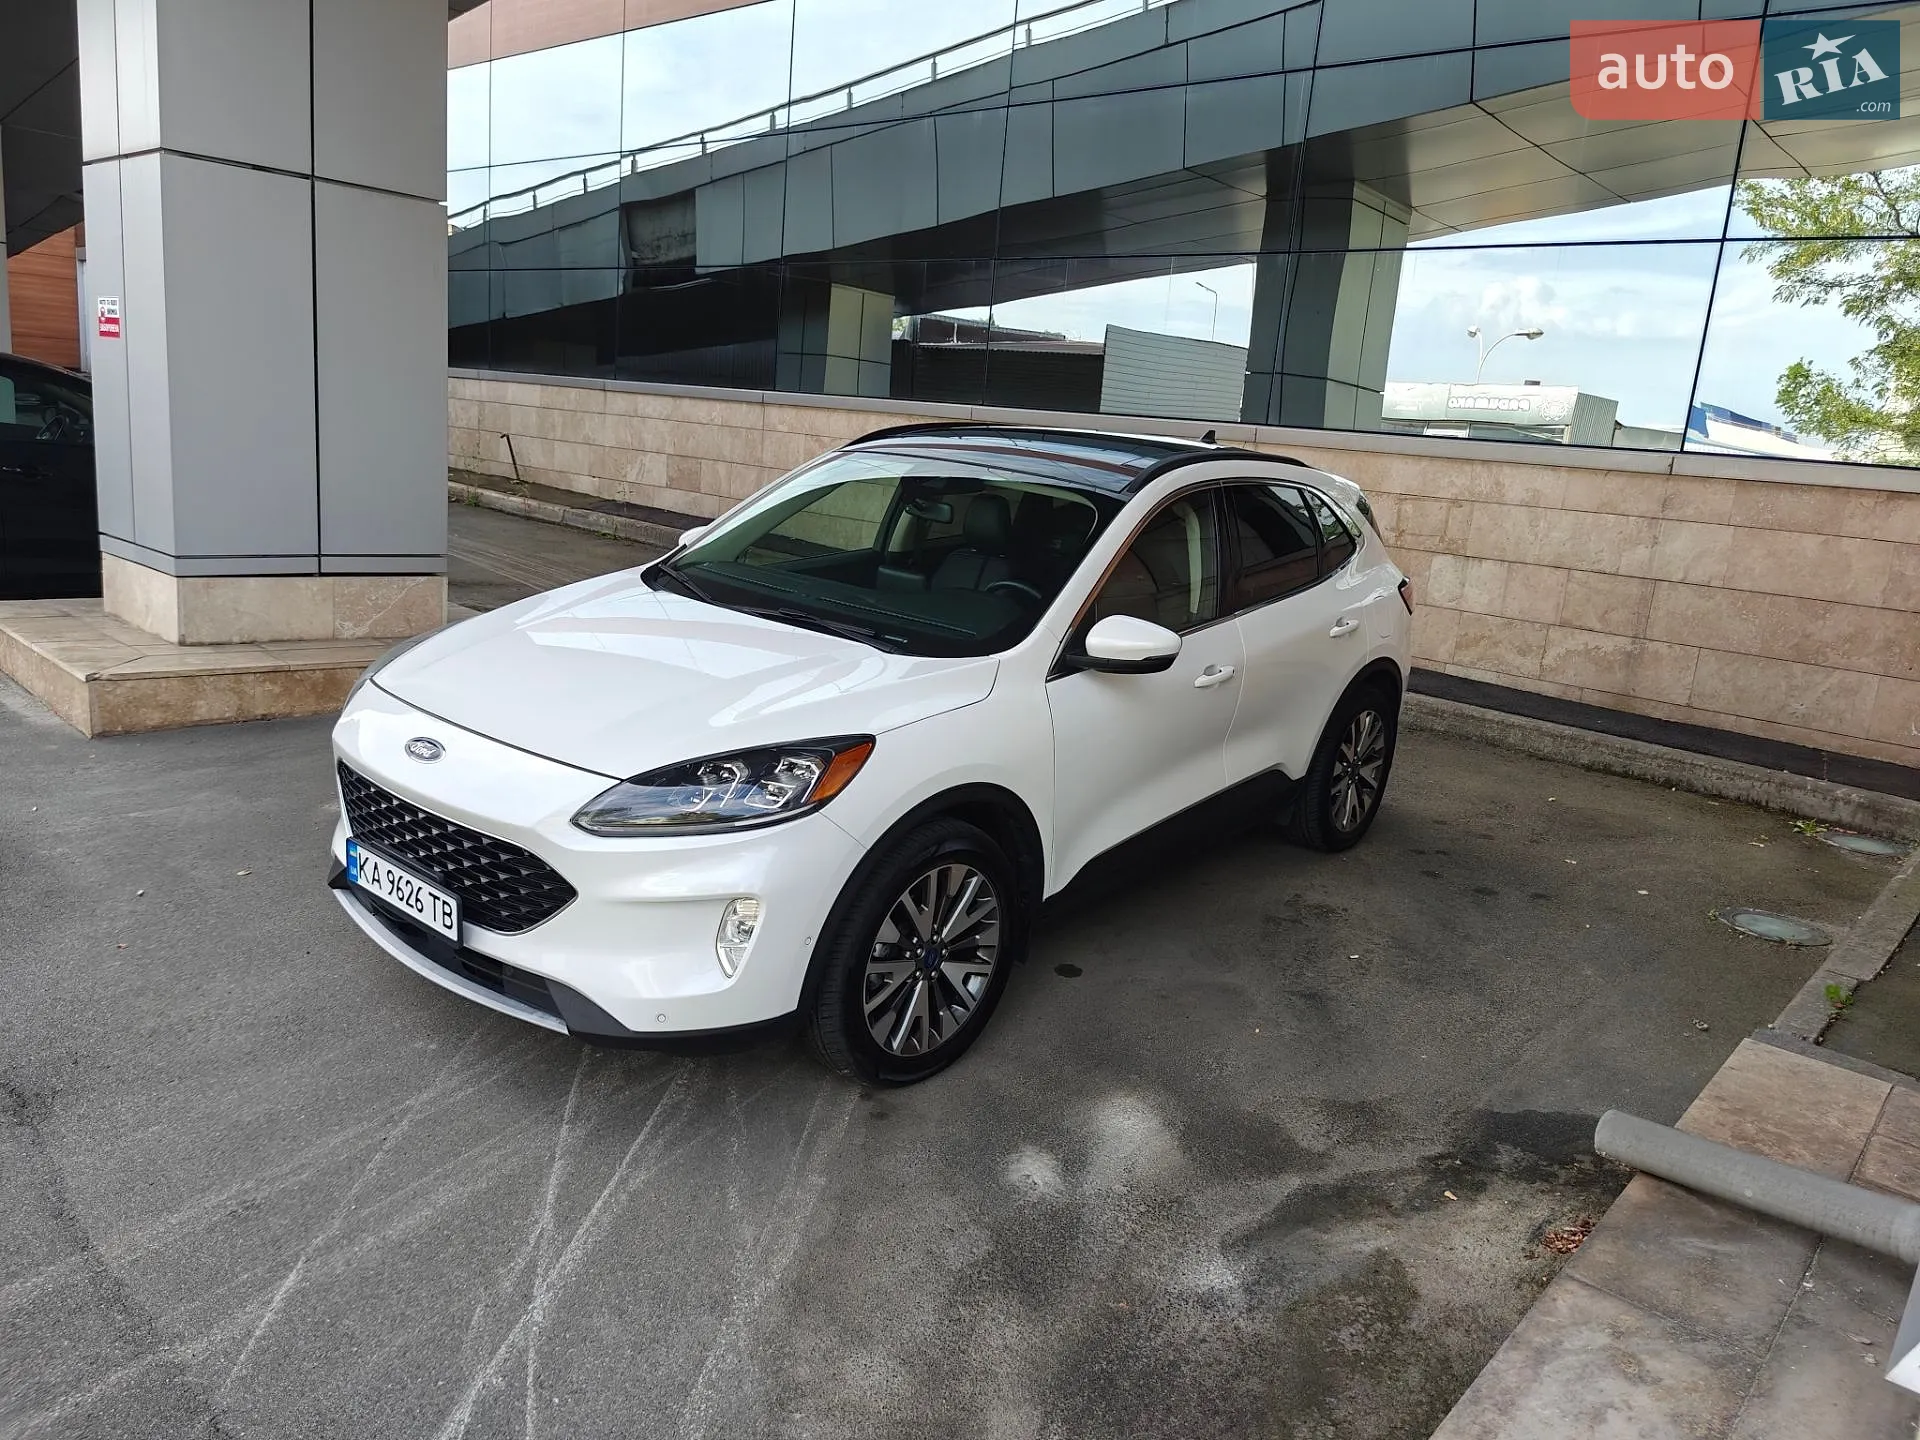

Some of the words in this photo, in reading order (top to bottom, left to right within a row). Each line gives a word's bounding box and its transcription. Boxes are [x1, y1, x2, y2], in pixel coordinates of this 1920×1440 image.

[358, 852, 382, 890] KA
[386, 869, 424, 913] 9626
[428, 892, 453, 930] TB
